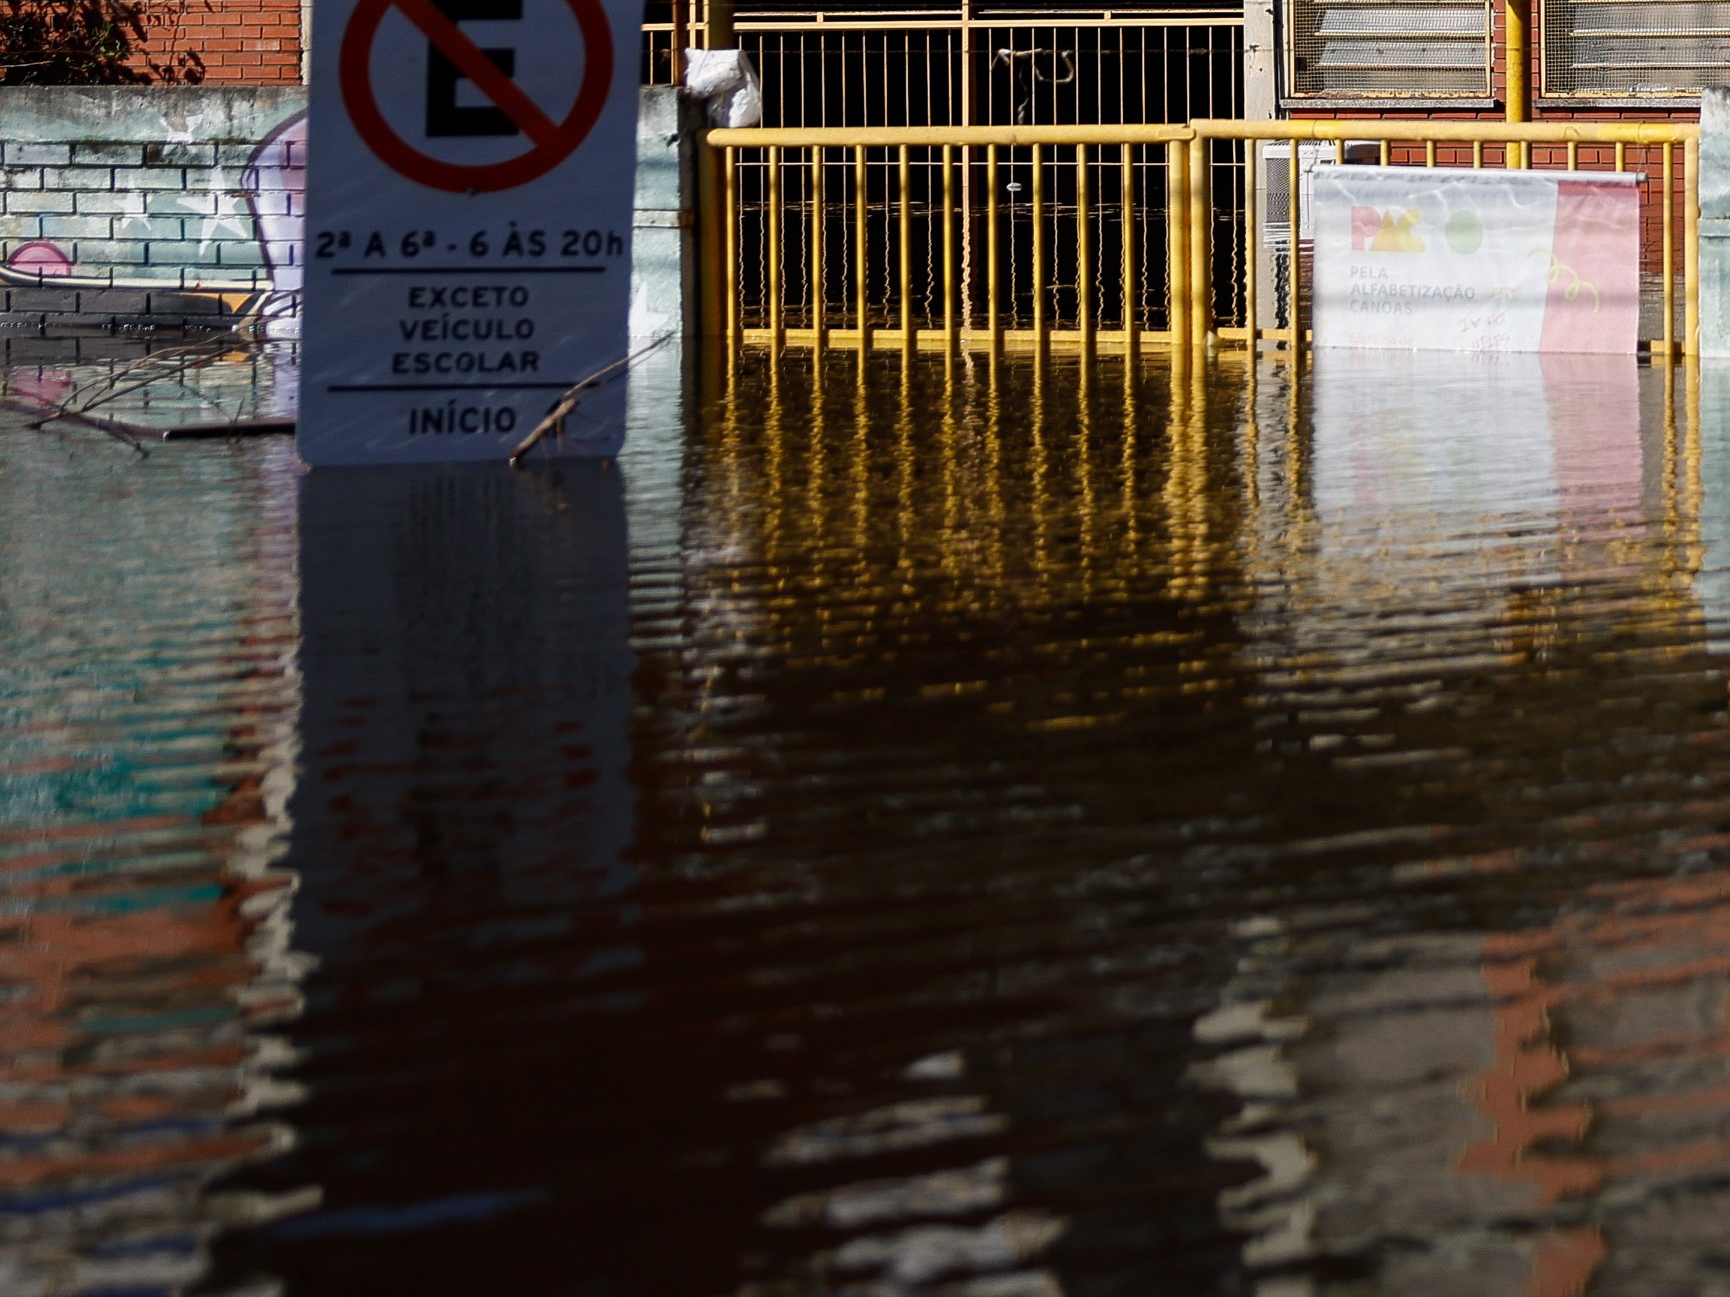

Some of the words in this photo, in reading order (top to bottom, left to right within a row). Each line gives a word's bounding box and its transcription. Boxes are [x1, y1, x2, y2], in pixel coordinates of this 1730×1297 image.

[364, 231, 387, 258] A
[469, 230, 488, 257] 6
[502, 221, 546, 257] ÀS
[560, 229, 624, 257] 20h
[1350, 265, 1389, 280] PELA
[408, 285, 530, 309] EXCETO
[1350, 282, 1476, 302] ALFABETIZAÇÃO
[1350, 299, 1413, 316] CANOAS
[399, 314, 535, 341] VEÍCULO
[391, 351, 540, 374] ESCOLAR
[409, 400, 517, 435] INÍCIO
